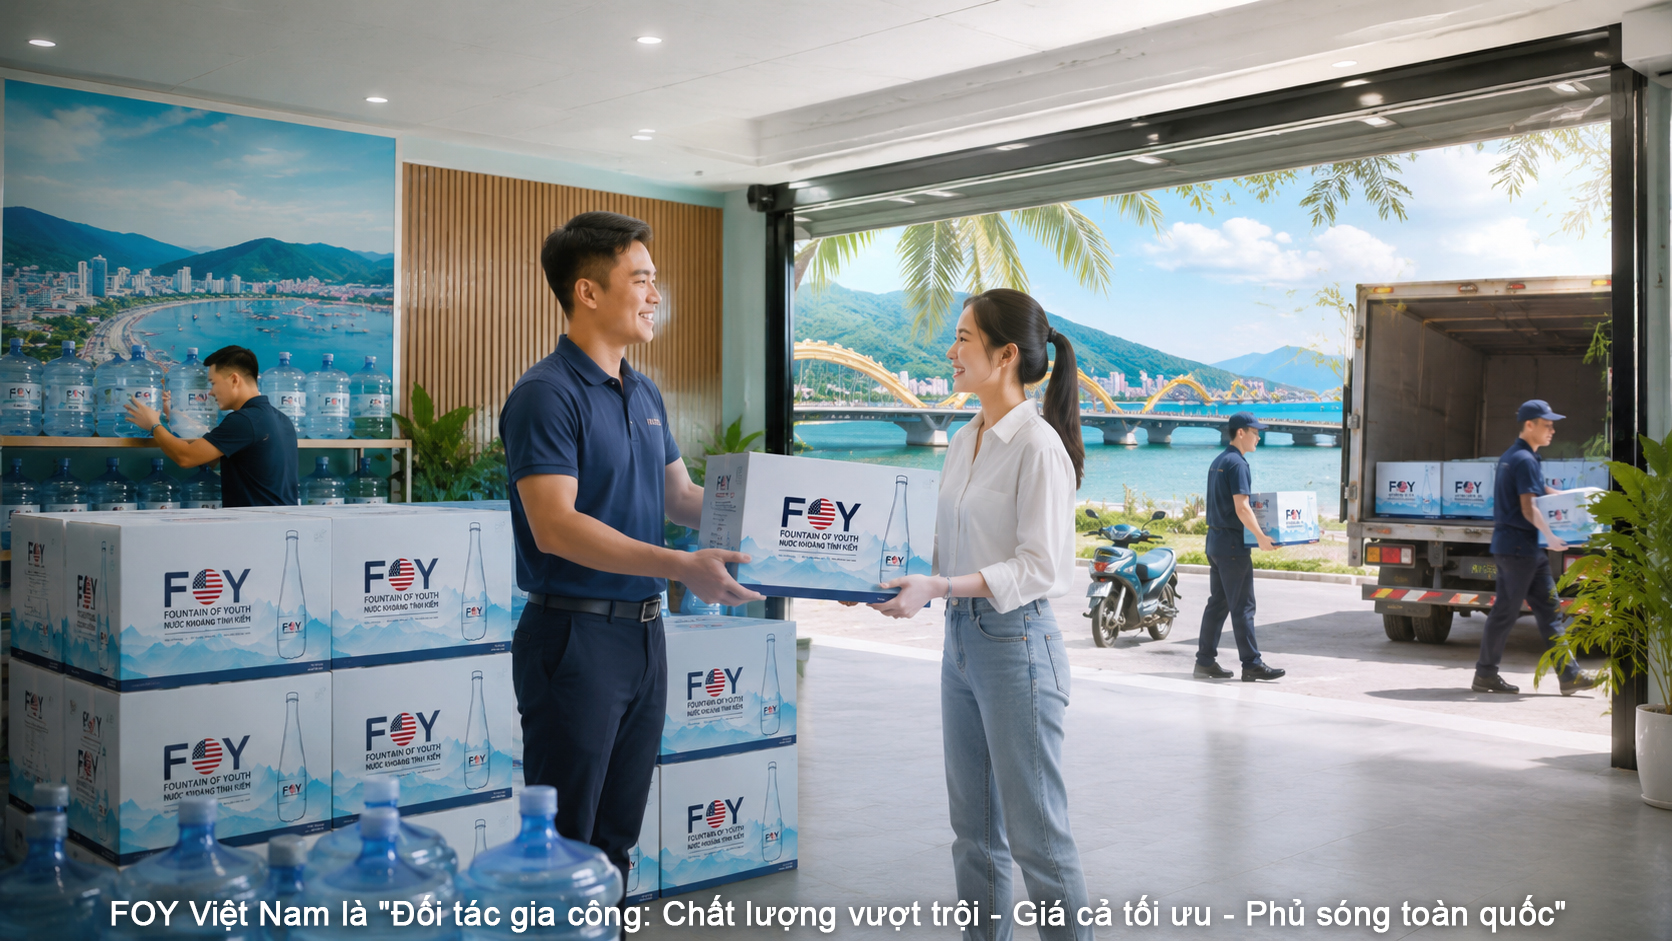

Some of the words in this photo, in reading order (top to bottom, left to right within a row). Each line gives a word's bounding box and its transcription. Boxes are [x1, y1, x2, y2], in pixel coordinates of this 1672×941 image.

[1389, 480, 1415, 493] FOY
[1455, 481, 1482, 493] FOY
[781, 496, 862, 532] FOY
[1286, 509, 1302, 521] FOY
[780, 529, 820, 540] FOUNTAIN
[821, 533, 832, 541] OF
[833, 533, 859, 543] YOUTH
[886, 555, 904, 565] FOY
[364, 557, 439, 593] FOY
[165, 568, 251, 608] FOY
[364, 594, 402, 604] FOUNTAIN
[403, 592, 414, 600] OF
[415, 591, 439, 600] YOUTH
[164, 608, 208, 620] FOUNTAIN
[209, 607, 222, 616] OF
[223, 605, 251, 615] YOUTH
[466, 606, 483, 616] FOY
[282, 621, 302, 631] FOY
[687, 666, 743, 700] FOY
[763, 705, 778, 714] FOY
[366, 709, 441, 751] FOY
[164, 735, 251, 781] FOY
[366, 749, 404, 761] FOUNTAIN
[416, 743, 441, 753] YOUTH
[468, 754, 486, 765] FOY
[164, 777, 208, 792] FOUNTAIN
[209, 776, 221, 785] OF
[223, 771, 251, 782] YOUTH
[282, 783, 302, 795] FOY
[688, 796, 744, 834] FOY
[765, 831, 779, 840] FOY
